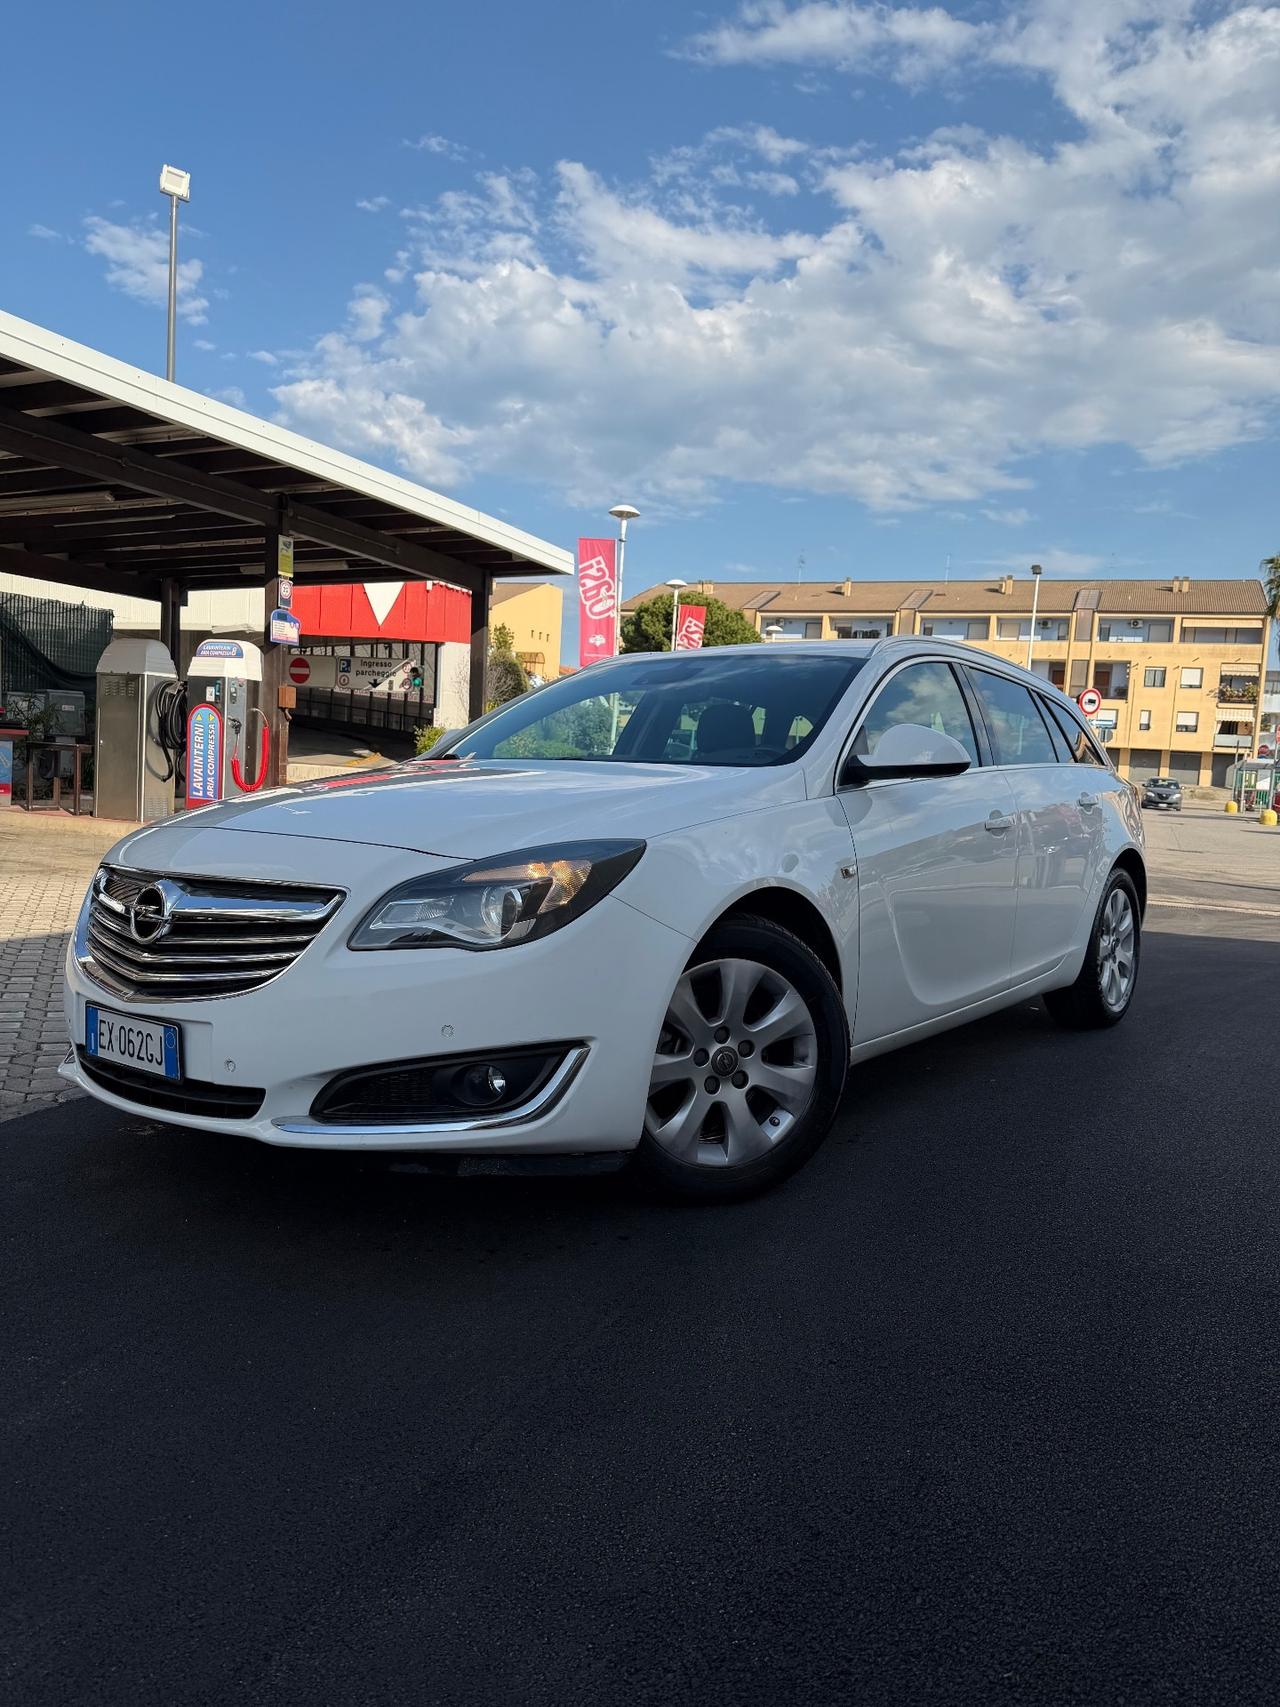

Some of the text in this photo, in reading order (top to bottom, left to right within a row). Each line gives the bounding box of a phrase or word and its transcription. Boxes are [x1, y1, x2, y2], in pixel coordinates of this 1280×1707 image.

[355, 668, 396, 677] parcheggio
[360, 660, 392, 669] Ingresso
[193, 724, 204, 797] LAVAINTERNI
[207, 724, 215, 798] ARIA COMPRESSA
[99, 1020, 163, 1066] EX 062GJ
